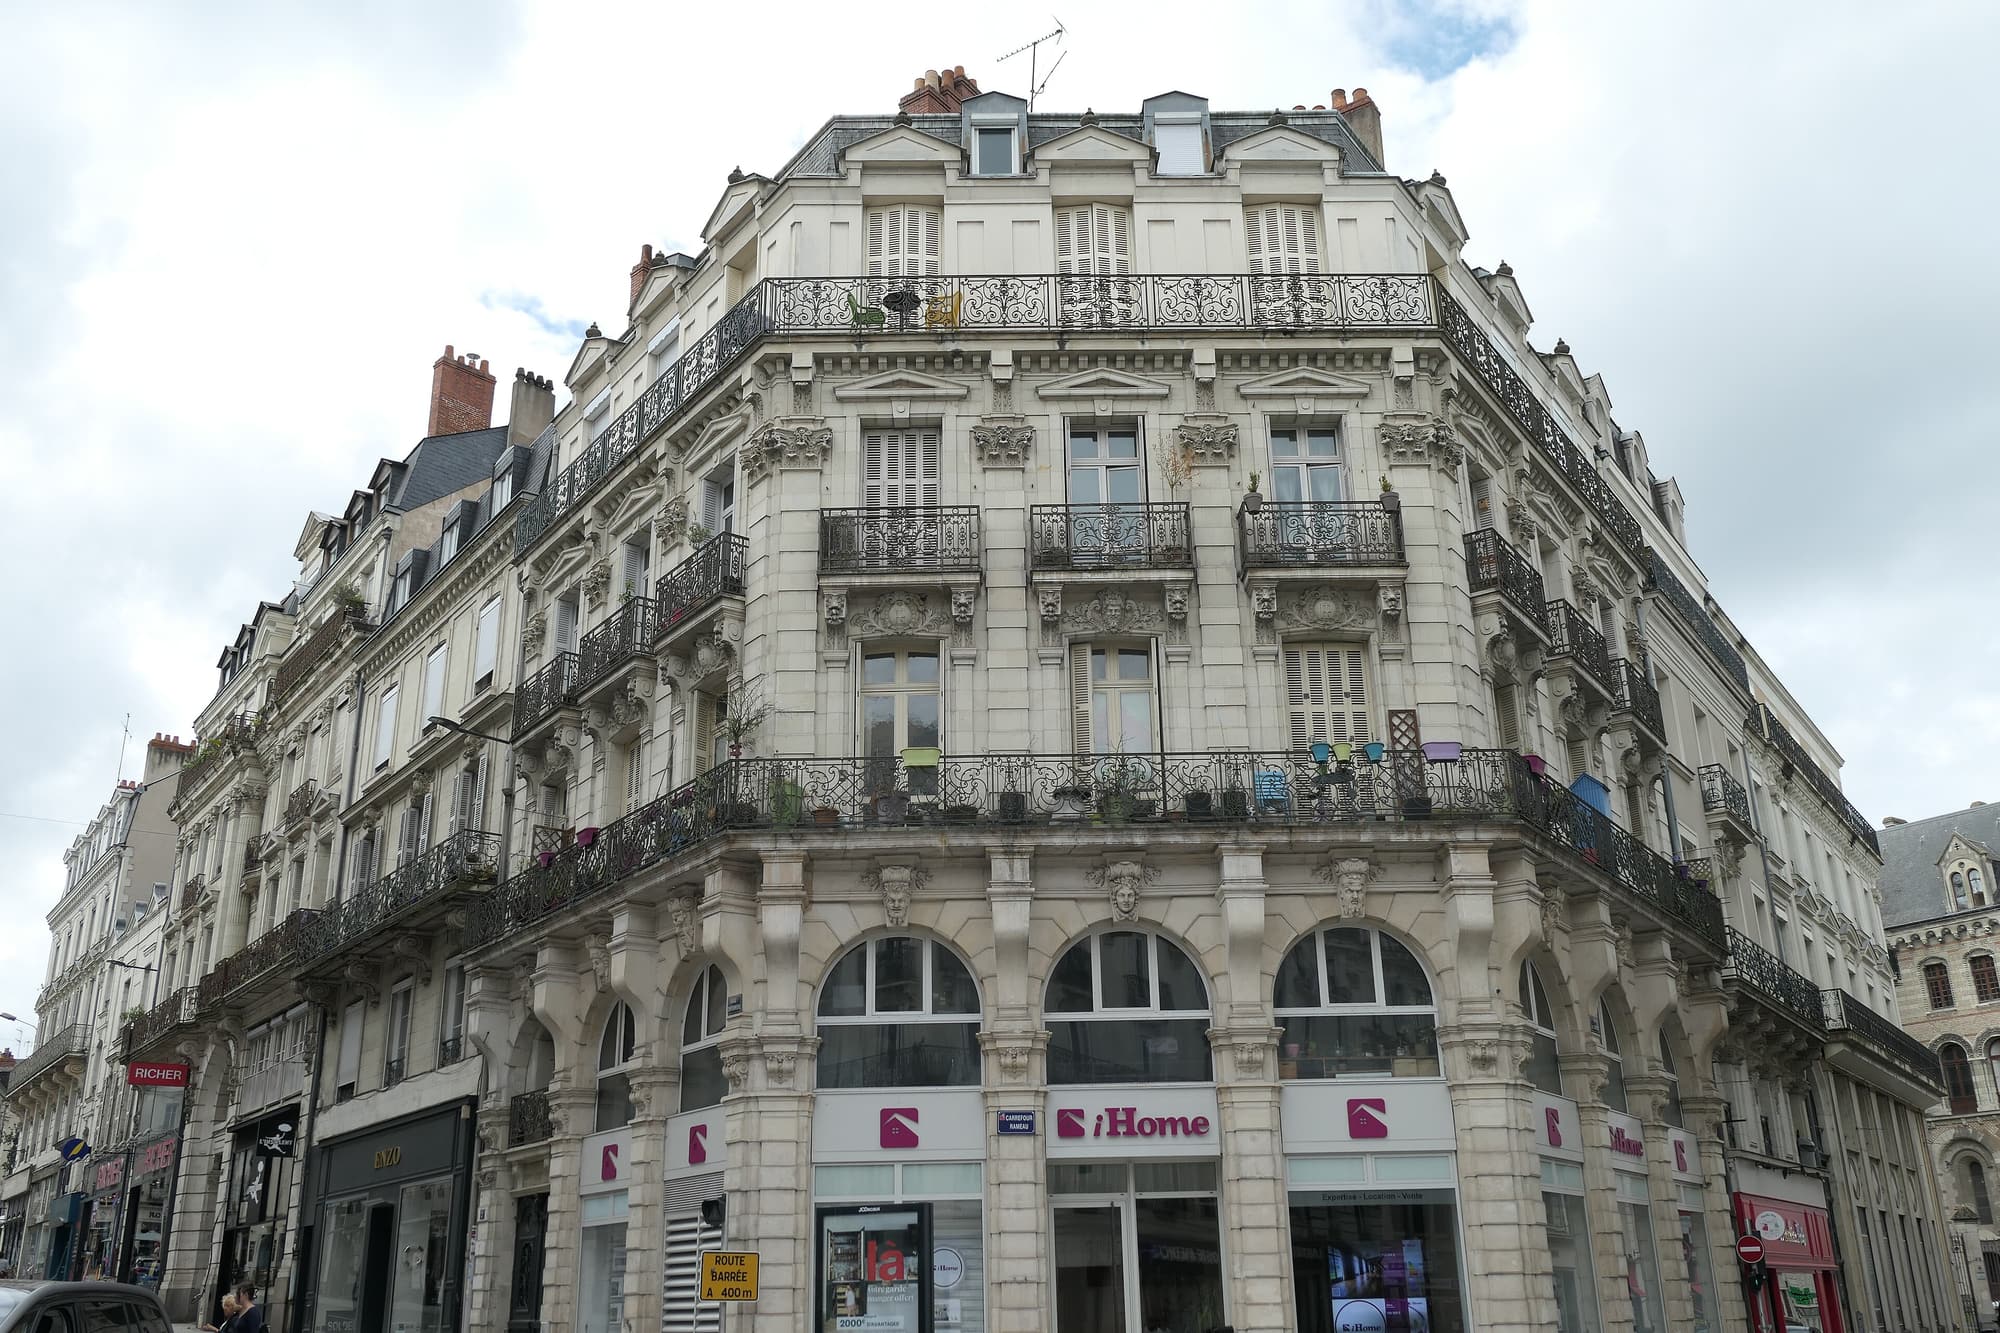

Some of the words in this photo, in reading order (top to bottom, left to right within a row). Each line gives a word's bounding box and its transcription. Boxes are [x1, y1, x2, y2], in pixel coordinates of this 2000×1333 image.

[135, 1067, 182, 1080] RICHER
[1093, 1107, 1210, 1137] iHome
[374, 1146, 401, 1169] ENZO
[1322, 1193, 1357, 1202] Expertise
[1363, 1192, 1396, 1201] Location
[1401, 1192, 1424, 1200] Vente
[715, 1255, 746, 1266] ROUTE
[867, 1239, 905, 1281] là
[711, 1269, 748, 1282] BARRÉE
[706, 1287, 713, 1298] A
[721, 1287, 741, 1298] 400
[894, 1293, 914, 1302] offert
